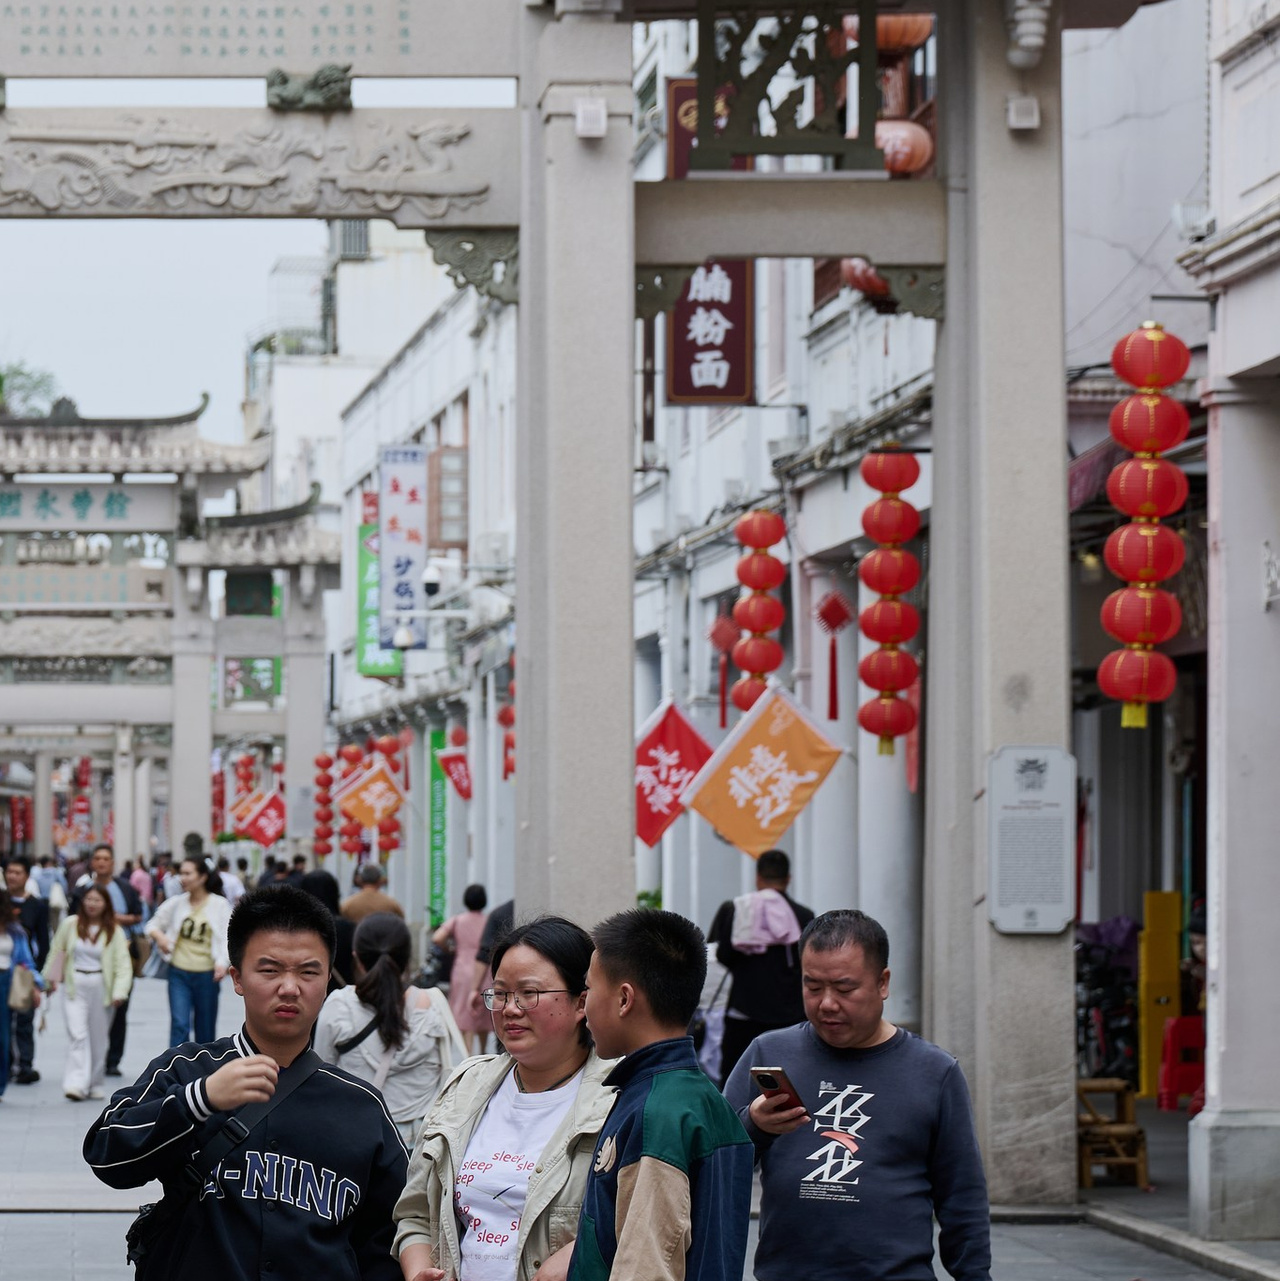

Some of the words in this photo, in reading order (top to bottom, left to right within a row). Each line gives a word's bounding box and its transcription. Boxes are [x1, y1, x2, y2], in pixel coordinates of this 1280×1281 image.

[462, 1159, 493, 1173] sleep
[516, 1161, 535, 1171] sle
[456, 1174, 474, 1187] eep
[477, 1230, 509, 1246] sleep
